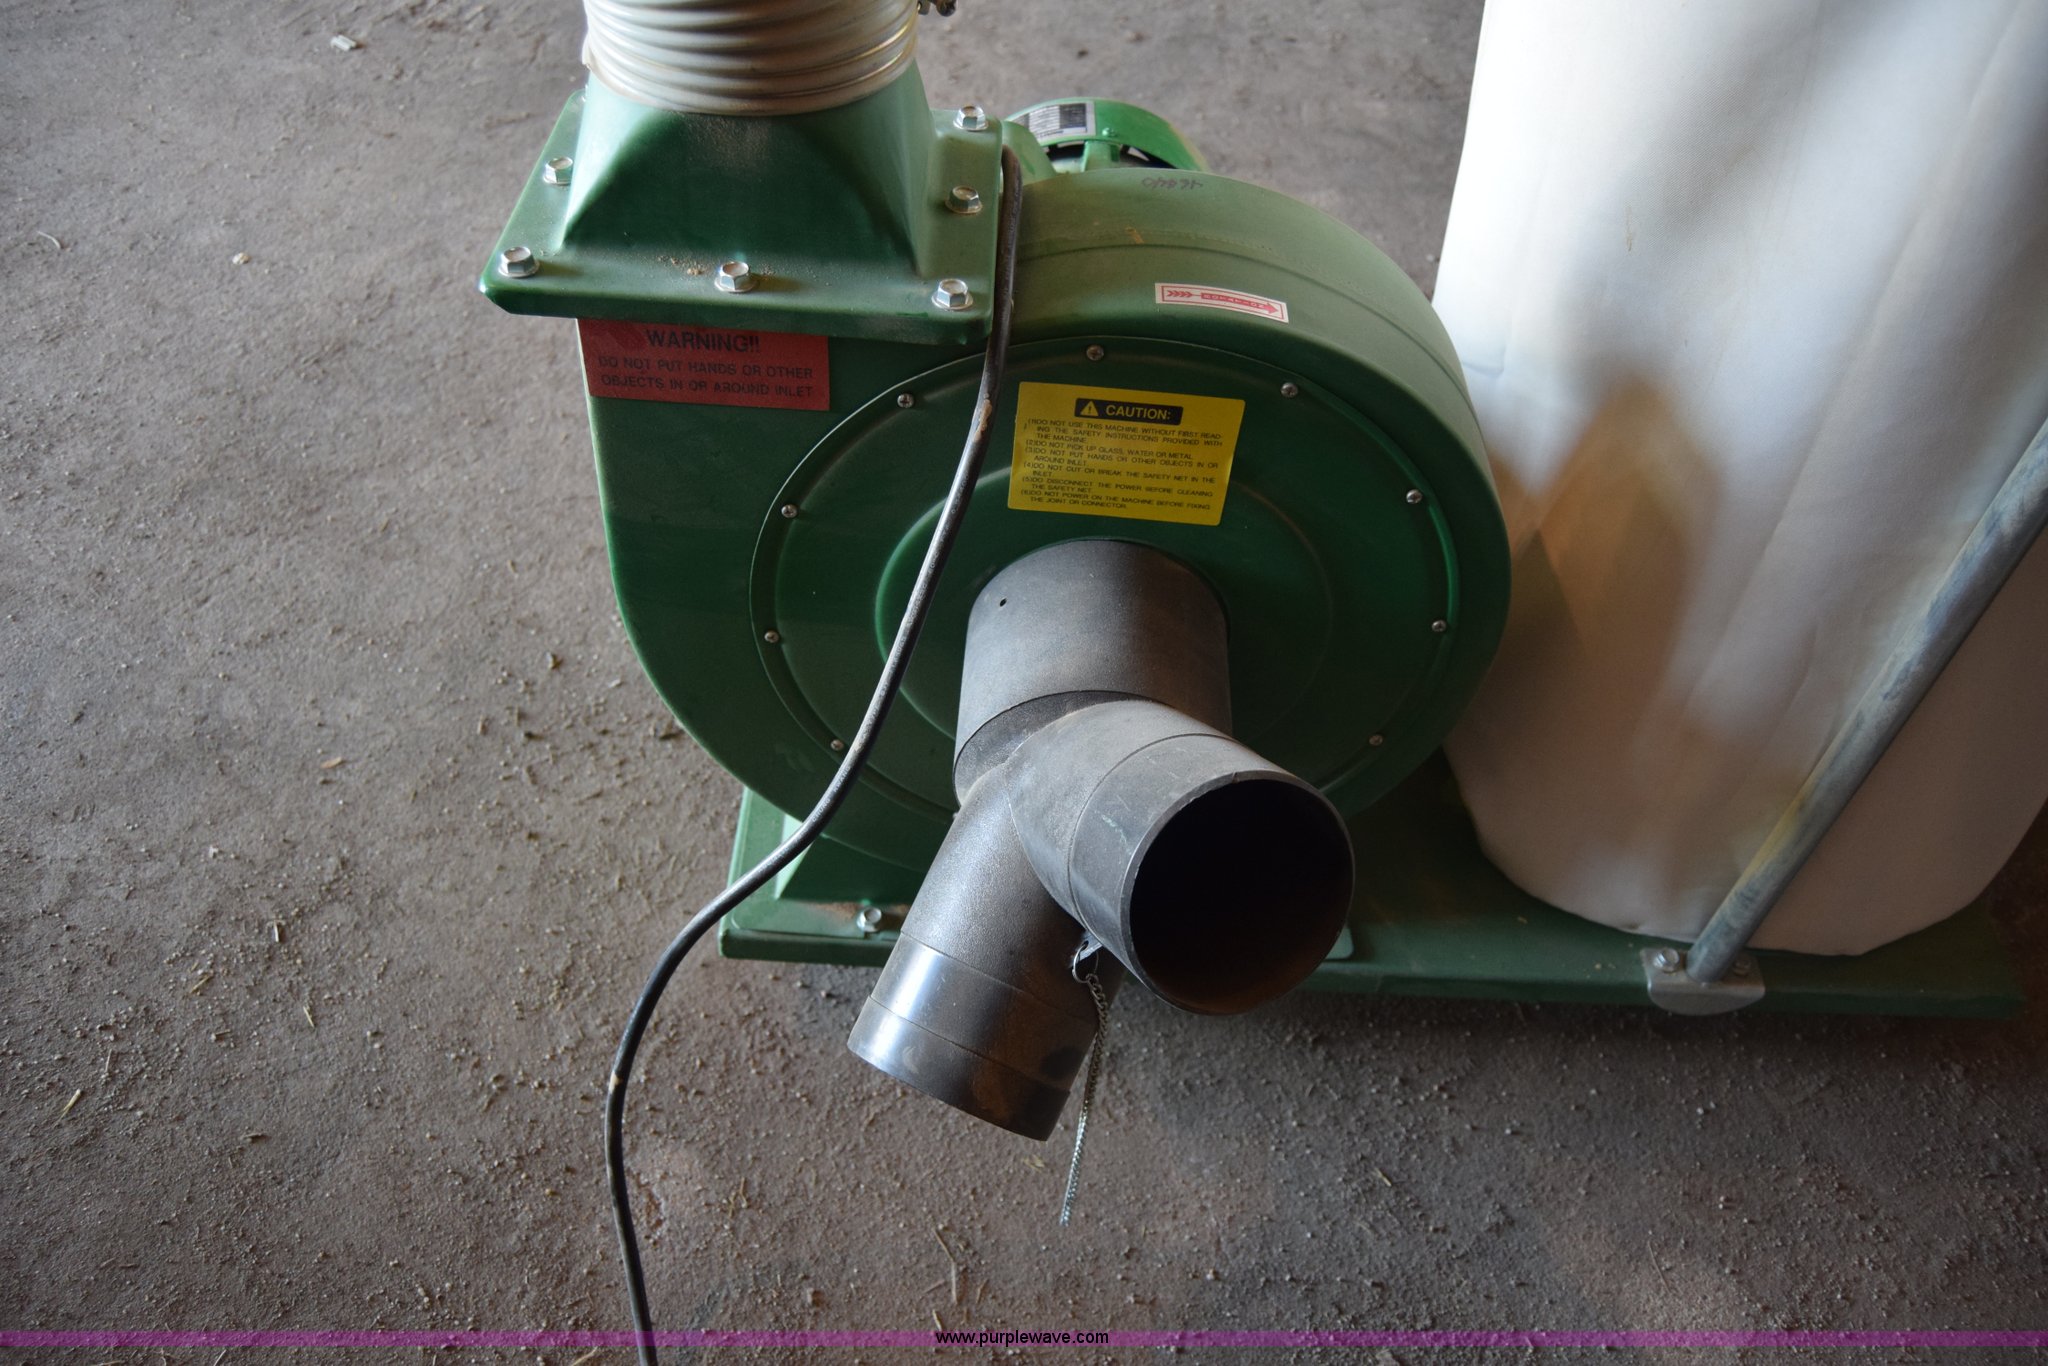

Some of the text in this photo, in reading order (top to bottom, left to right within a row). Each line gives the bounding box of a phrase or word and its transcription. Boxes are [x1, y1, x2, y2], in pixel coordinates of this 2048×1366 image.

[1203, 293, 1266, 308] ROTATION
[646, 329, 760, 353] WARNING!!
[599, 357, 813, 379] DO NOT PUT HANDS OR OTHER
[602, 374, 812, 397] OBJECTS IN OR AROUND INLET
[1106, 404, 1171, 420] CAUTION:
[1104, 425, 1137, 433] MACHINE
[1142, 428, 1175, 437] WITHOUT
[1105, 432, 1159, 442] INSTRUCTIONS
[1163, 437, 1200, 446] PROVIDED
[1034, 455, 1065, 464] AROUND
[1087, 452, 1113, 461] HANDS
[1131, 456, 1156, 464] OTHER
[1160, 459, 1193, 467] OBJECTS
[1127, 448, 1154, 456] WATER
[1046, 478, 1093, 487] DISCONNECT
[1177, 489, 1214, 497] CLEANING
[1121, 498, 1153, 506] MACHINE
